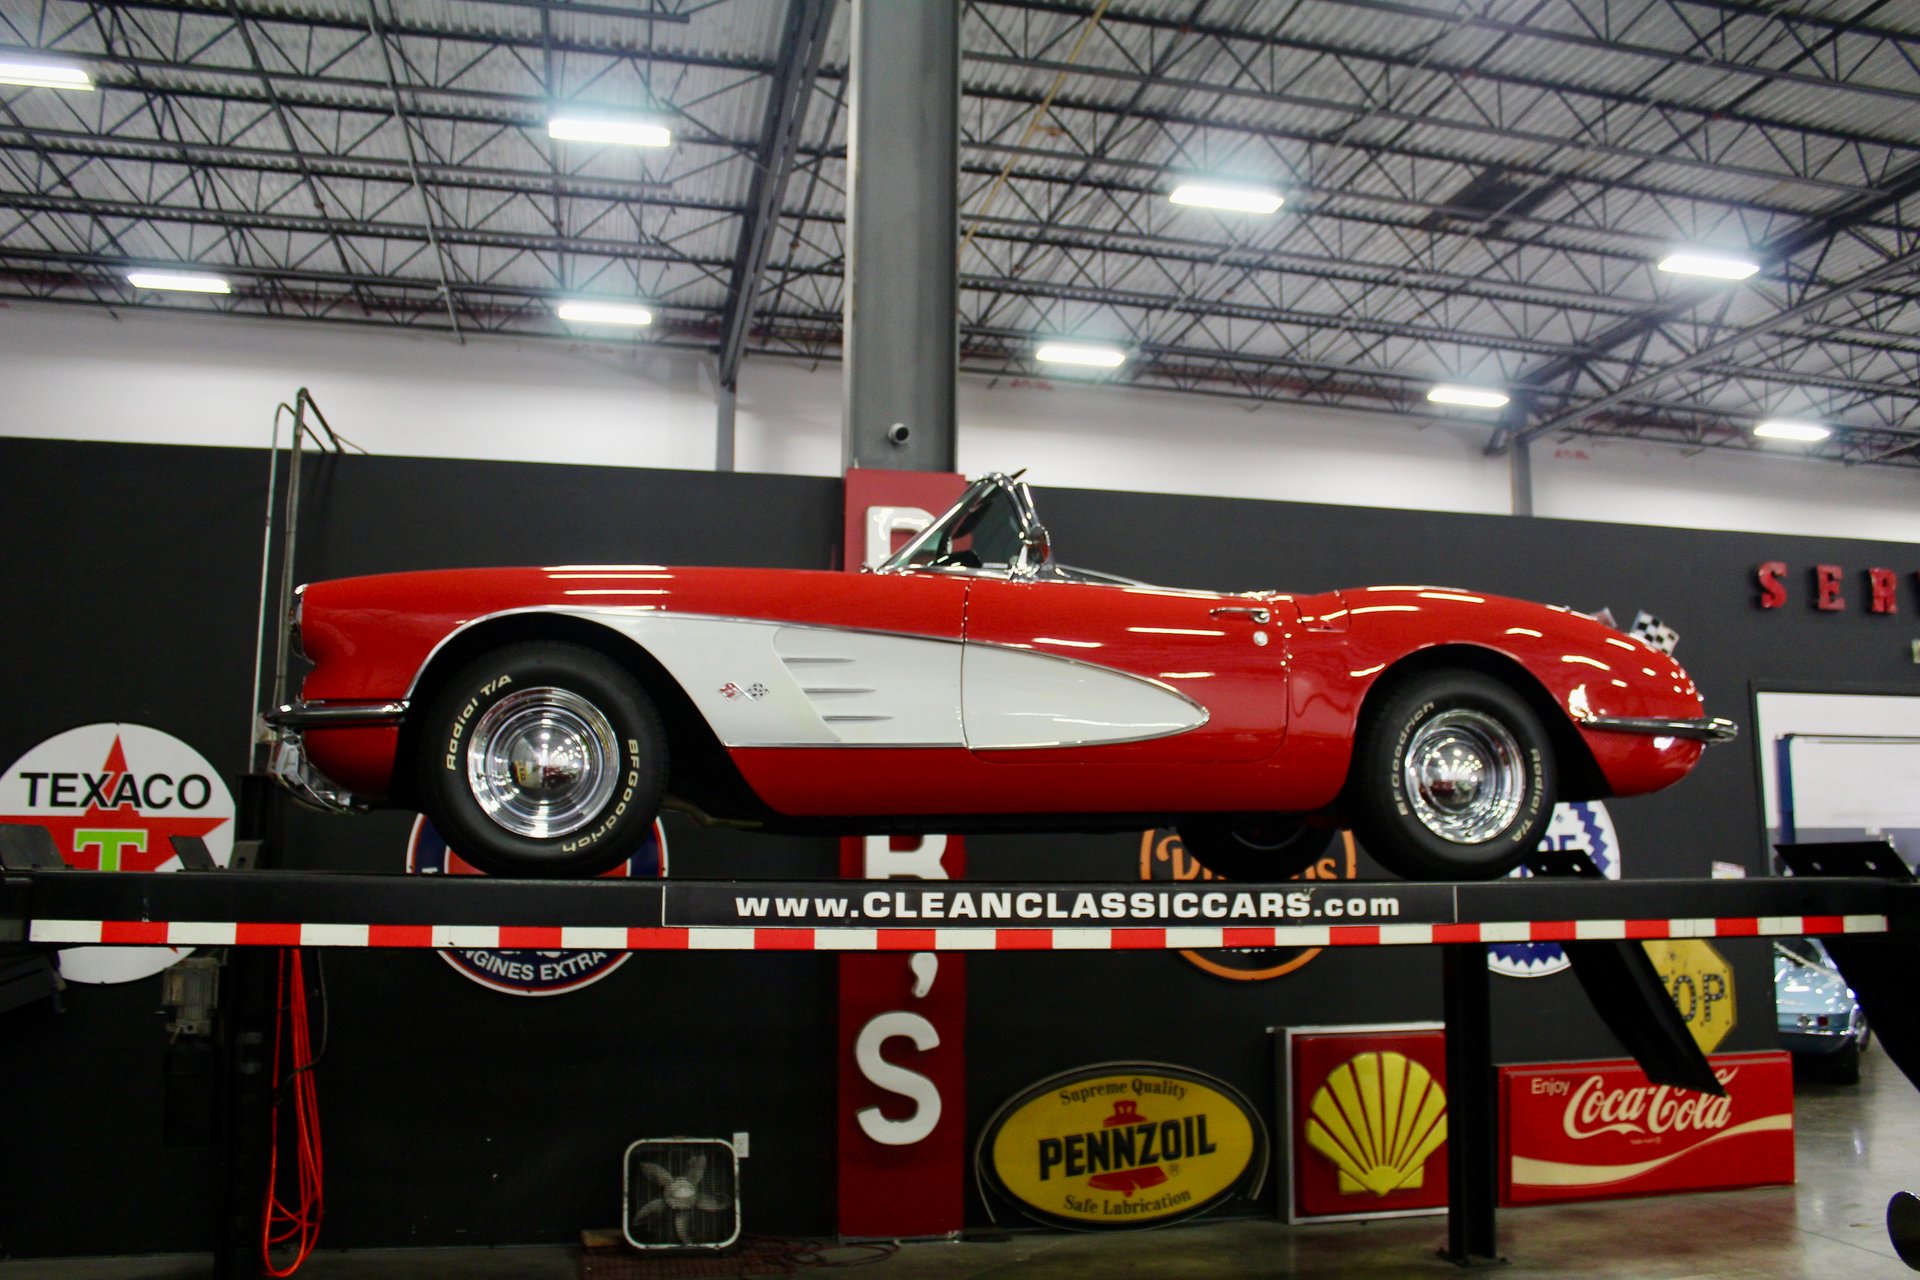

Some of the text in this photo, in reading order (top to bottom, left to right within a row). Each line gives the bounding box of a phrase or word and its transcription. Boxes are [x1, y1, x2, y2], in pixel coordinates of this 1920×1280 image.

[1758, 561, 1920, 614] SER
[446, 674, 513, 770] Radial T/A
[20, 772, 212, 810] TEXACO
[562, 739, 640, 853] BFGoodrich
[735, 891, 1401, 919] www.CLEANCLASSICCARS.com
[459, 950, 608, 981] NGINES EXTRA
[1059, 1078, 1188, 1105] Supreme Quality
[1531, 1077, 1571, 1097] Enjoy
[1038, 1114, 1217, 1181] PENNZOIL
[1063, 1190, 1192, 1216] Safe Lubrication
